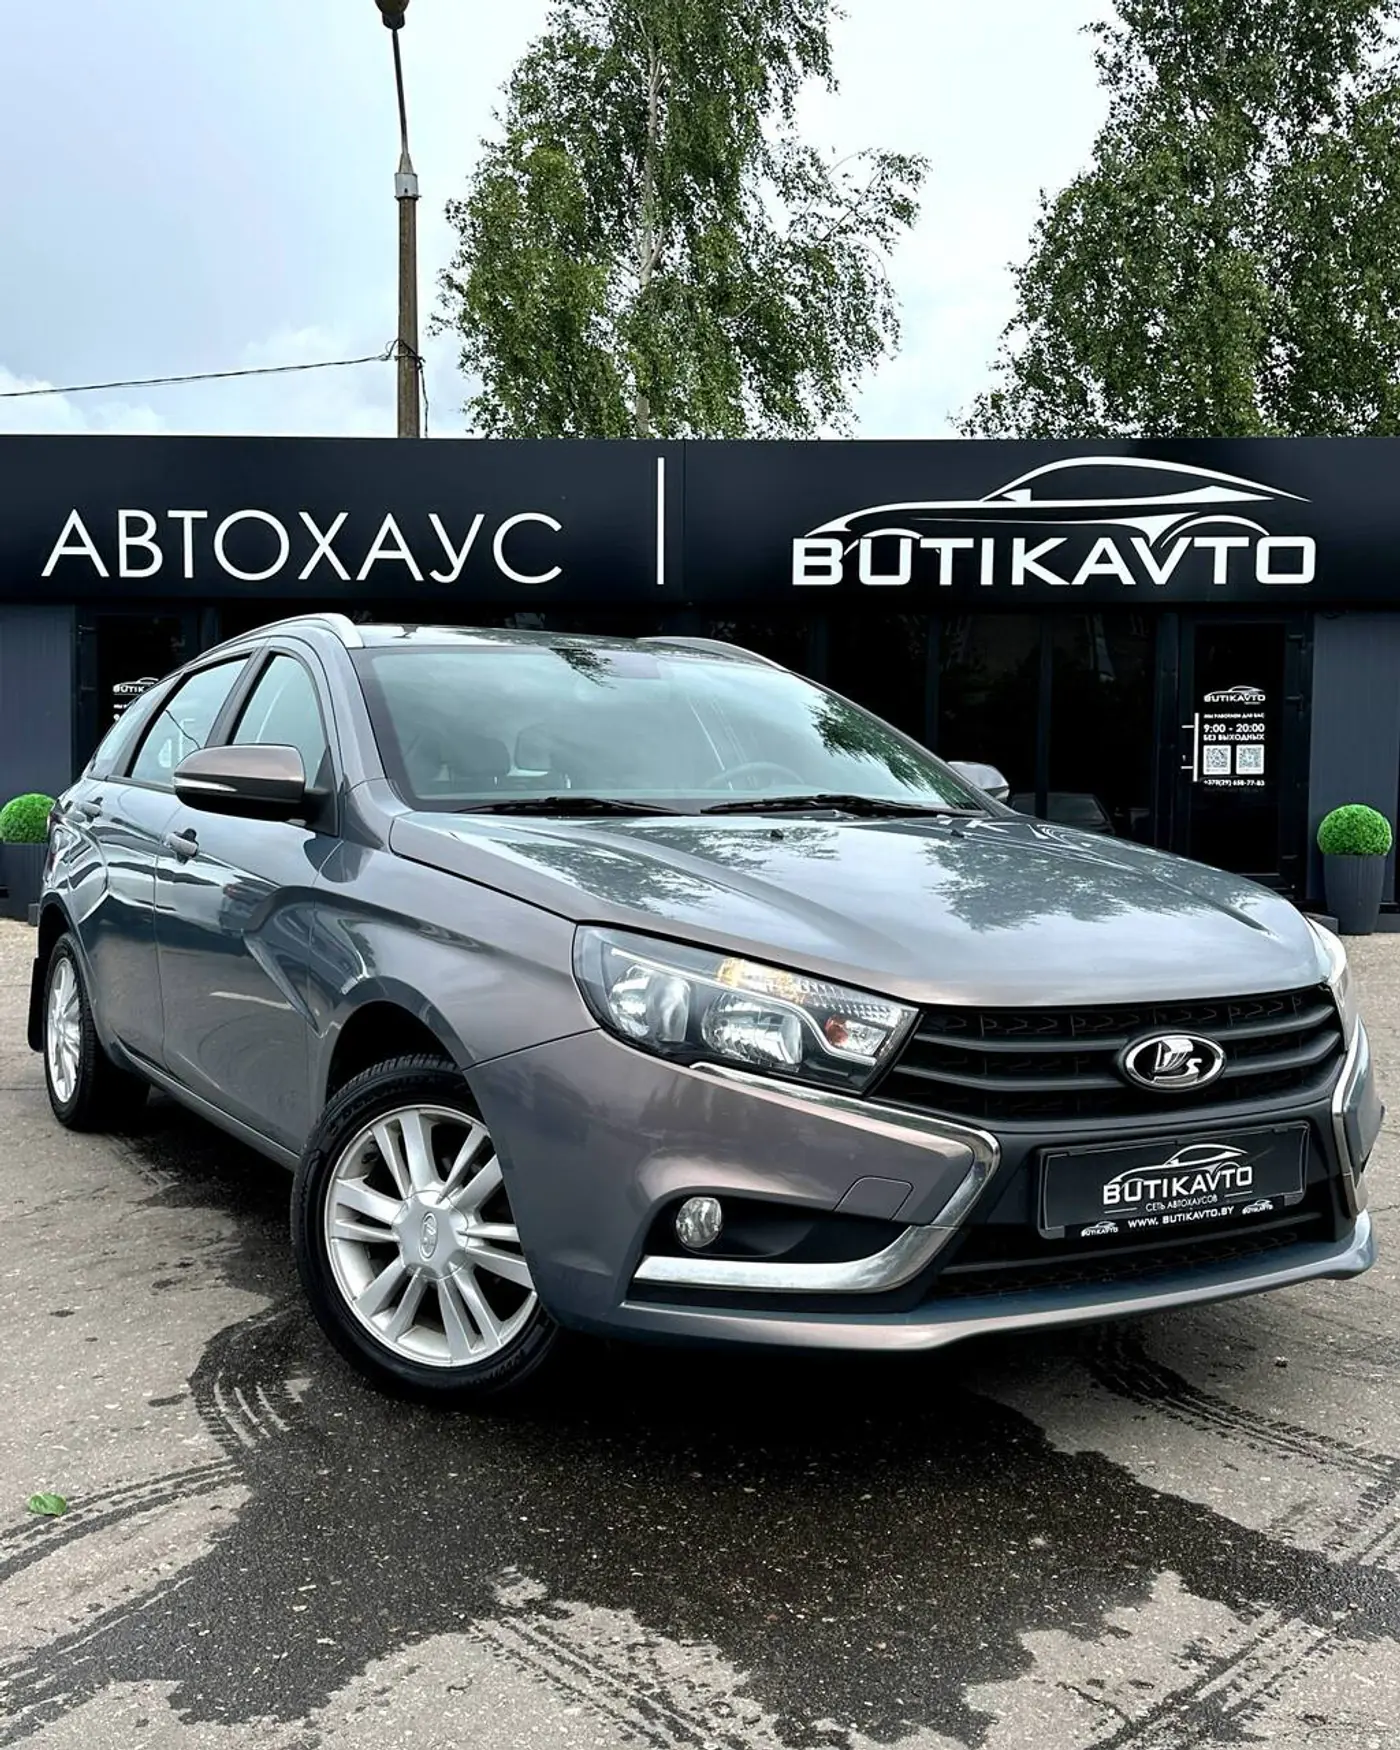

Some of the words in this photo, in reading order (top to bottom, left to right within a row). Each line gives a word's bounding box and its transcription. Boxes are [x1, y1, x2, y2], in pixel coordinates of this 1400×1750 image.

[41, 508, 563, 585] АВТОХАУС
[791, 534, 1317, 586] BUTIKAVTO
[1203, 694, 1266, 702] BUTIKAVTO
[1203, 723, 1226, 733] 9:00
[1235, 723, 1265, 733] 20:00
[1103, 1166, 1253, 1206] BUTIKAVTO
[1127, 1217, 1159, 1229] WWW.
[1162, 1206, 1235, 1224] BUTIKAVTO.BY
[1145, 1201, 1166, 1212] СЕТЬ
